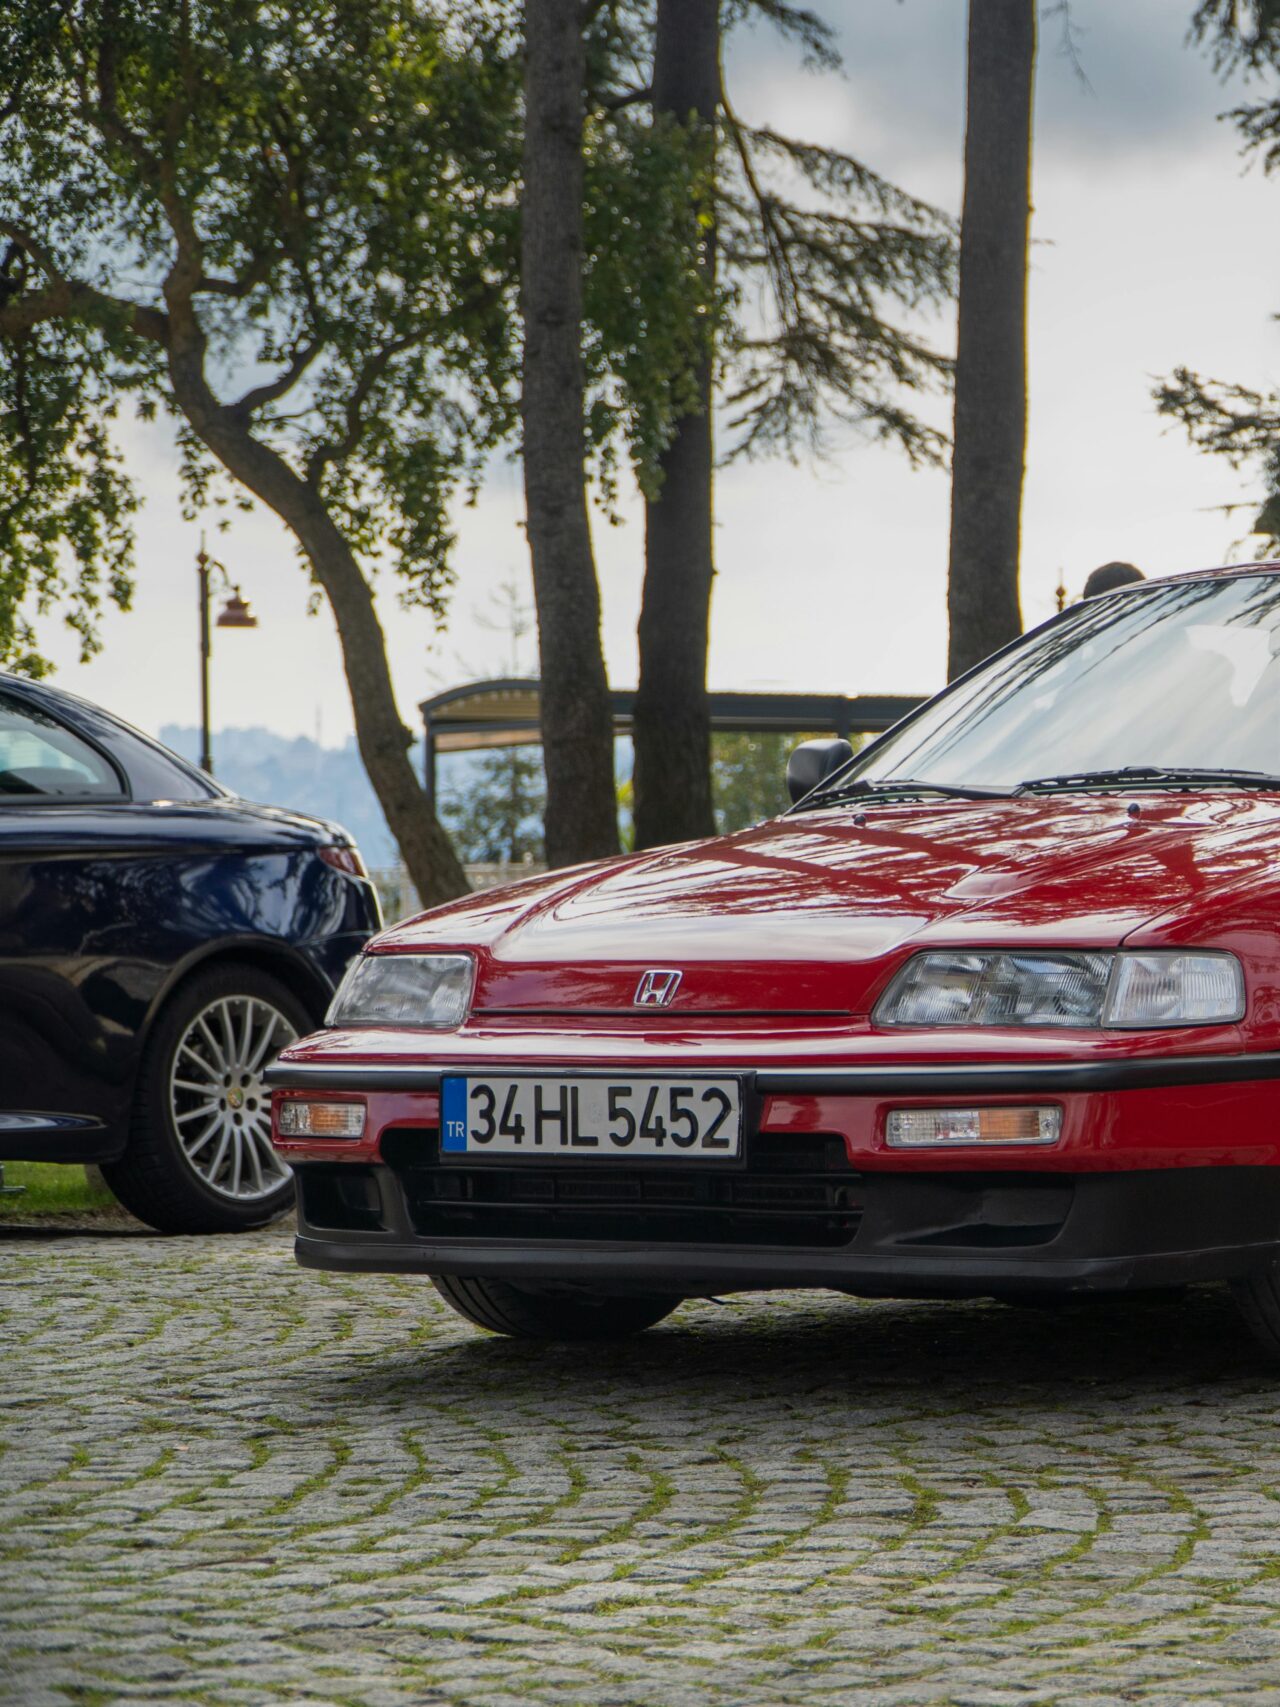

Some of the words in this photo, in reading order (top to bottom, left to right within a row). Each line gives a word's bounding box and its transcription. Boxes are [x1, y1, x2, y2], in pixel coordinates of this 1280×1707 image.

[446, 1121, 465, 1138] TR
[470, 1084, 525, 1144] 34
[534, 1085, 599, 1146] HL
[608, 1086, 733, 1148] 5452
